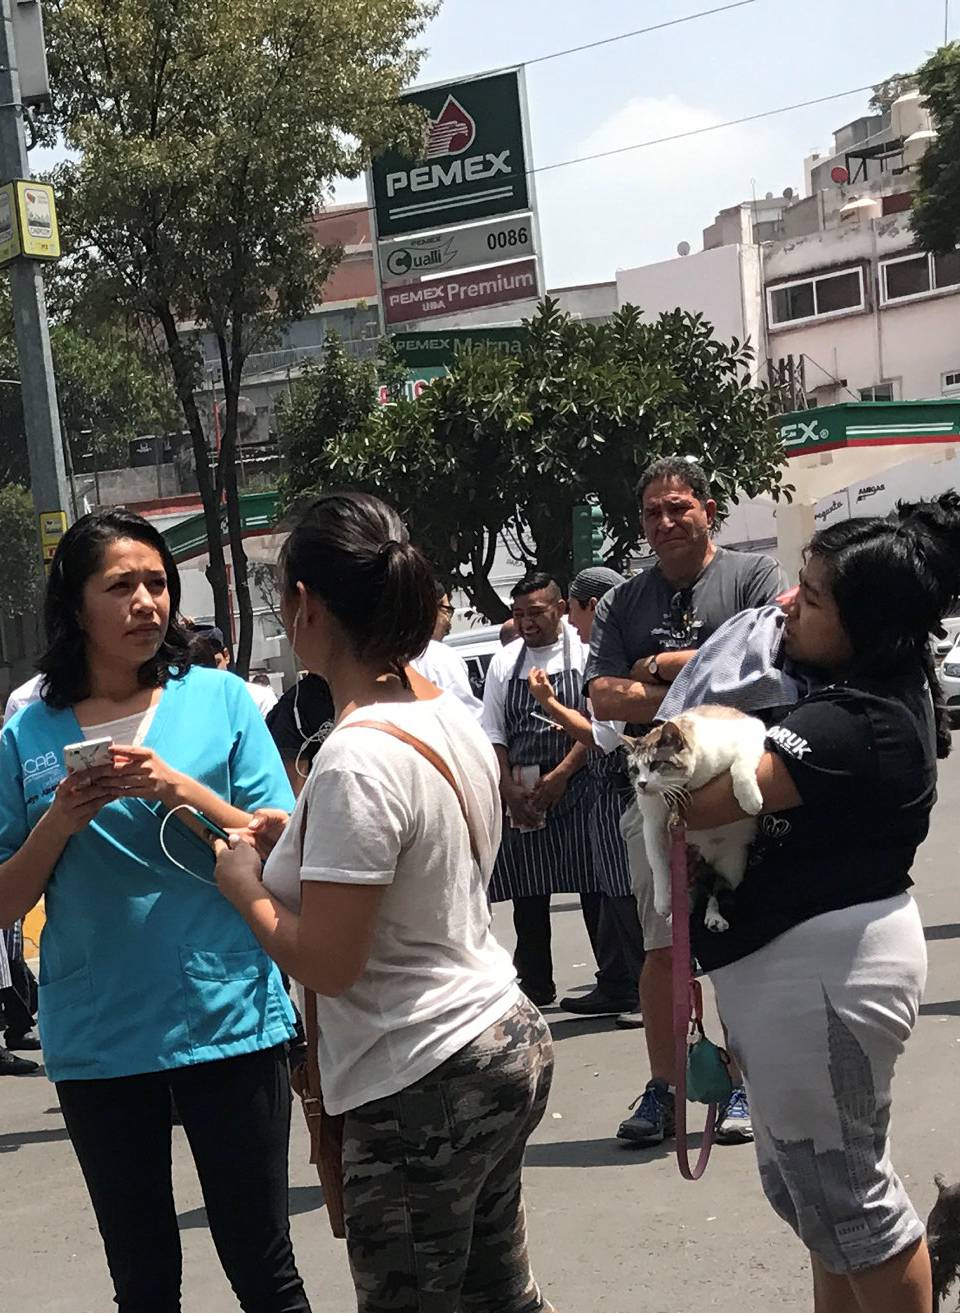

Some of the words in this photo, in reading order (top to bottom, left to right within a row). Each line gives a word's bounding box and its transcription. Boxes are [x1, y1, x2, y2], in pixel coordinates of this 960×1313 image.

[386, 150, 512, 197] PEMEX
[486, 227, 528, 250] 0086
[389, 285, 444, 307] PEMEX
[447, 272, 534, 302] Premium
[395, 338, 450, 351] PEMEX
[776, 419, 820, 447] EX
